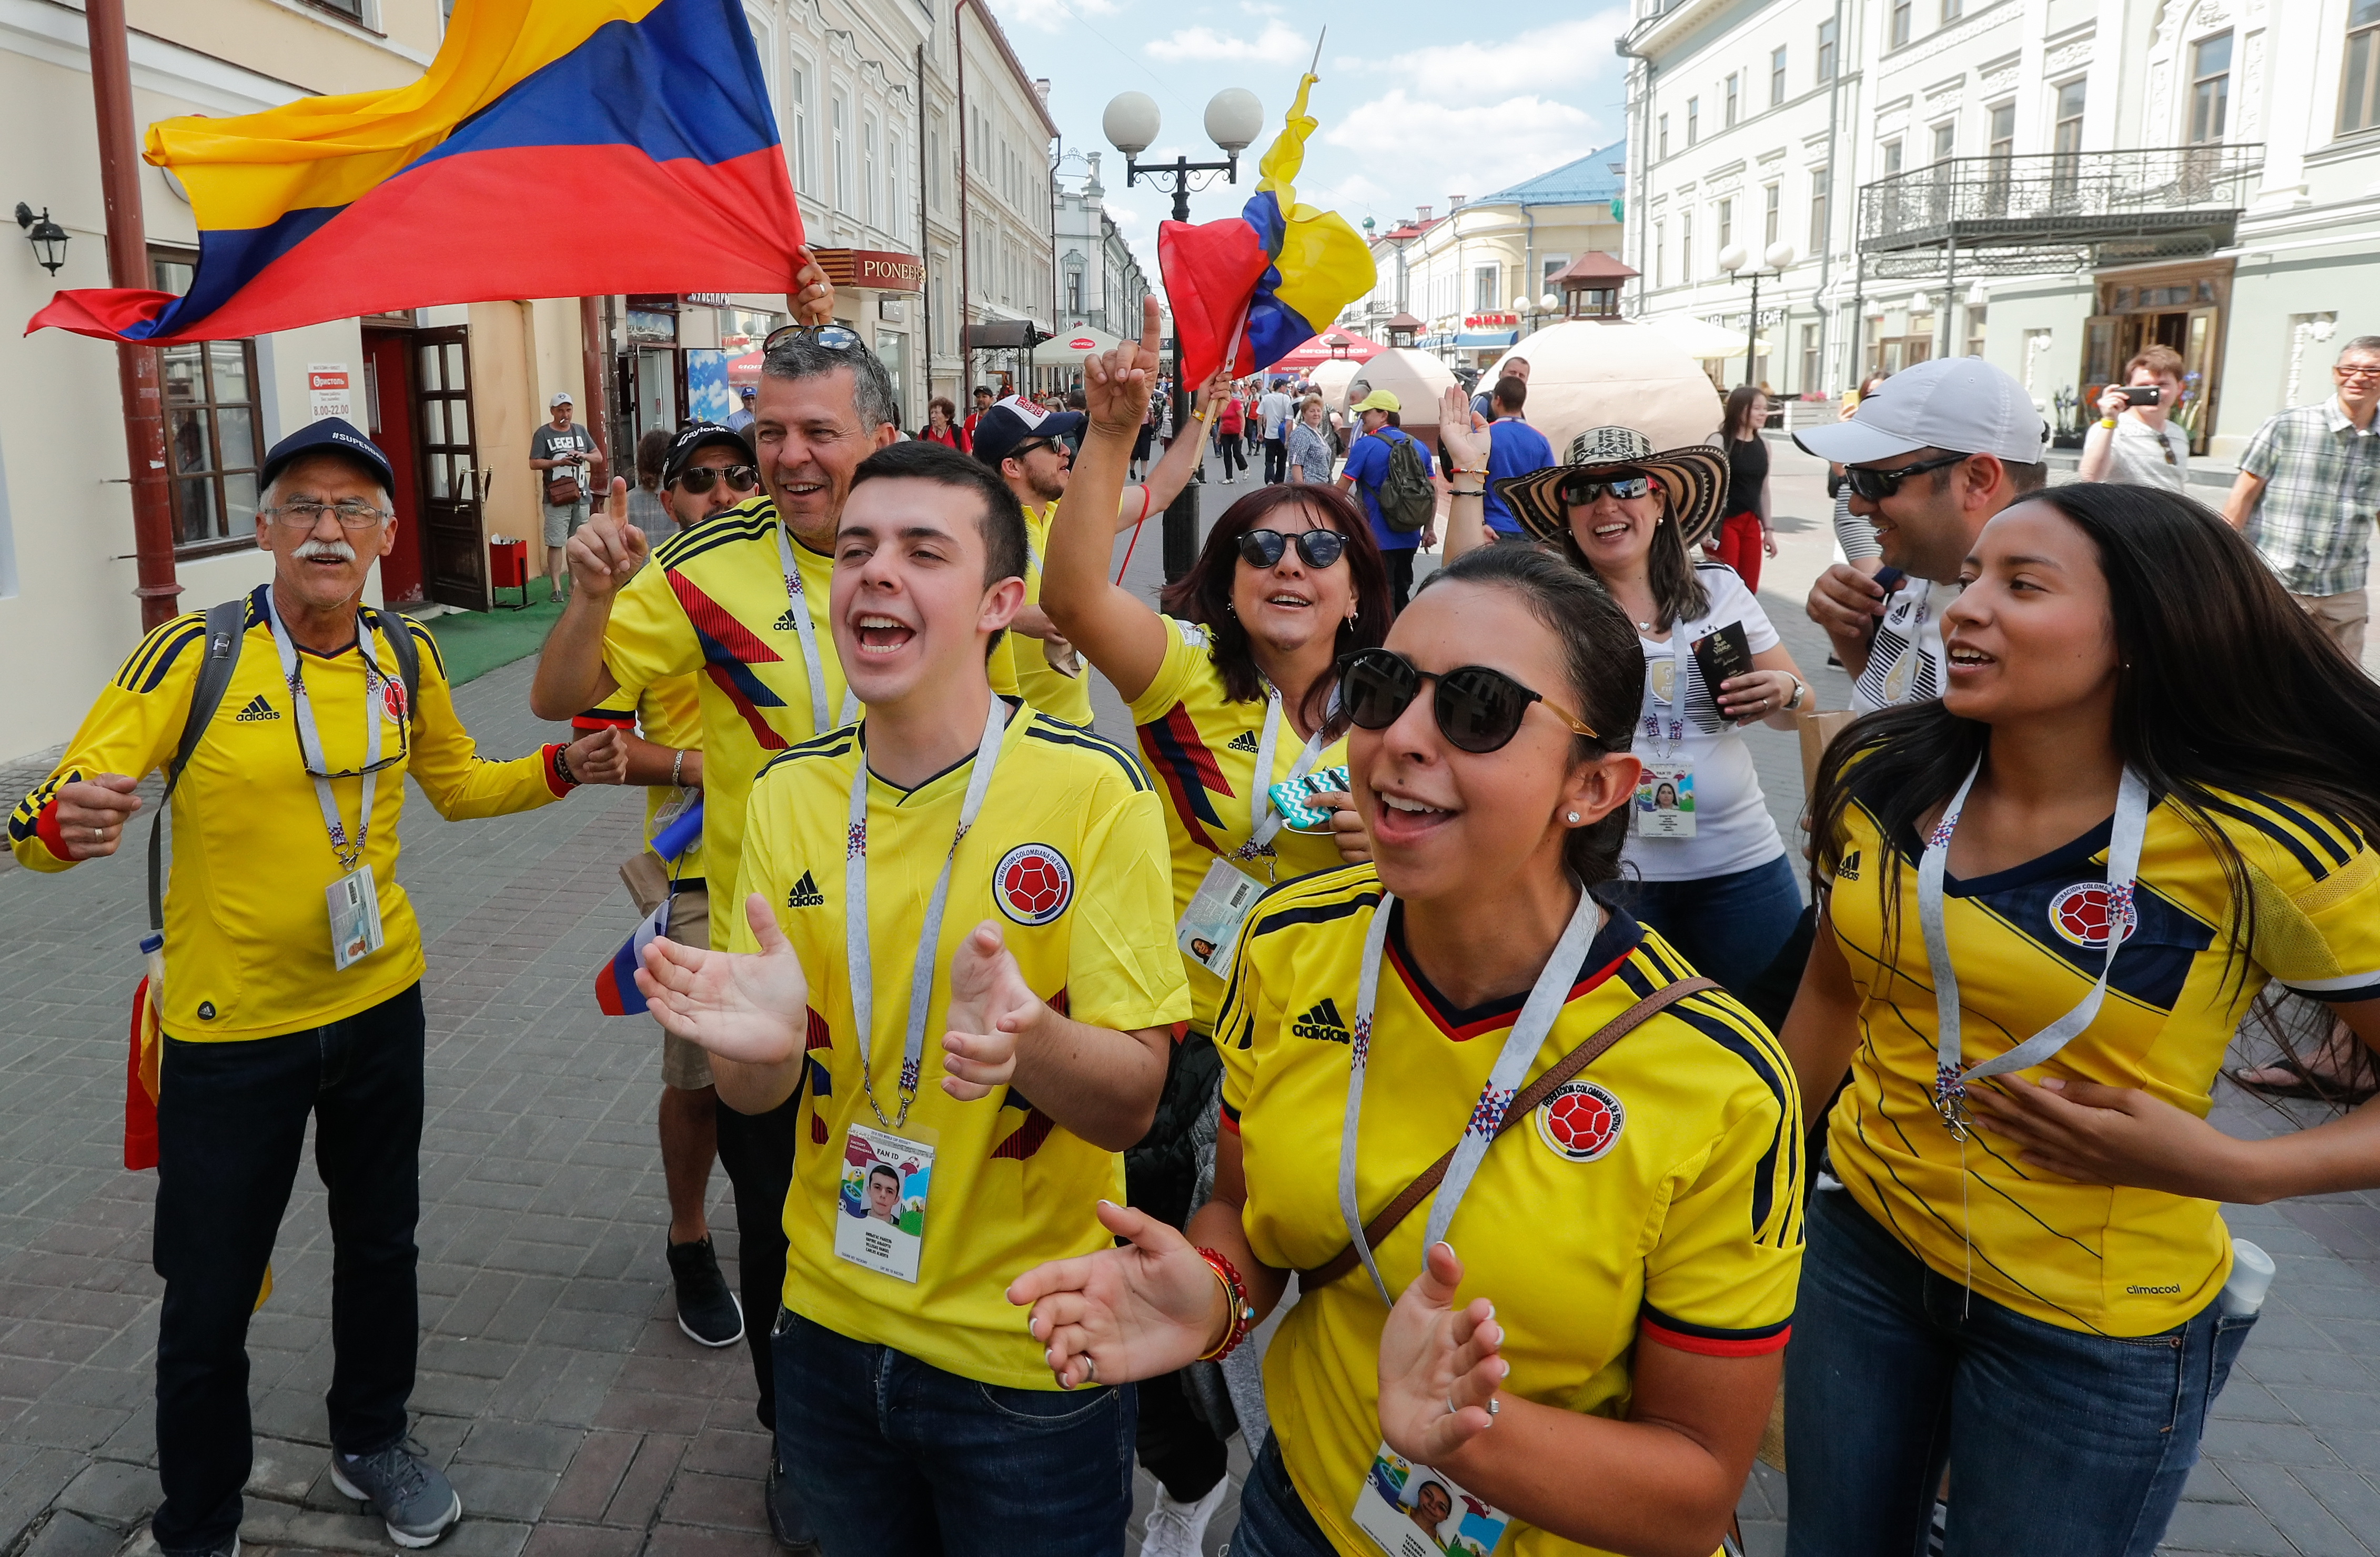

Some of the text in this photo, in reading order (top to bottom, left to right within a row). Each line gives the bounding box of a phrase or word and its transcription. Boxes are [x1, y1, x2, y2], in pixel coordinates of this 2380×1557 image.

[864, 260, 920, 281] PIONEER
[314, 405, 349, 416] 8.00-22.00
[236, 711, 281, 721] adidas
[997, 849, 1067, 886] FEDERACION COLOMBIANA DE FUTBOL
[788, 894, 824, 908] adidas
[2052, 884, 2082, 908] FEDERACION
[1292, 1024, 1350, 1045] adidas
[876, 1148, 890, 1158] FAN
[2126, 1283, 2181, 1294] climacool
